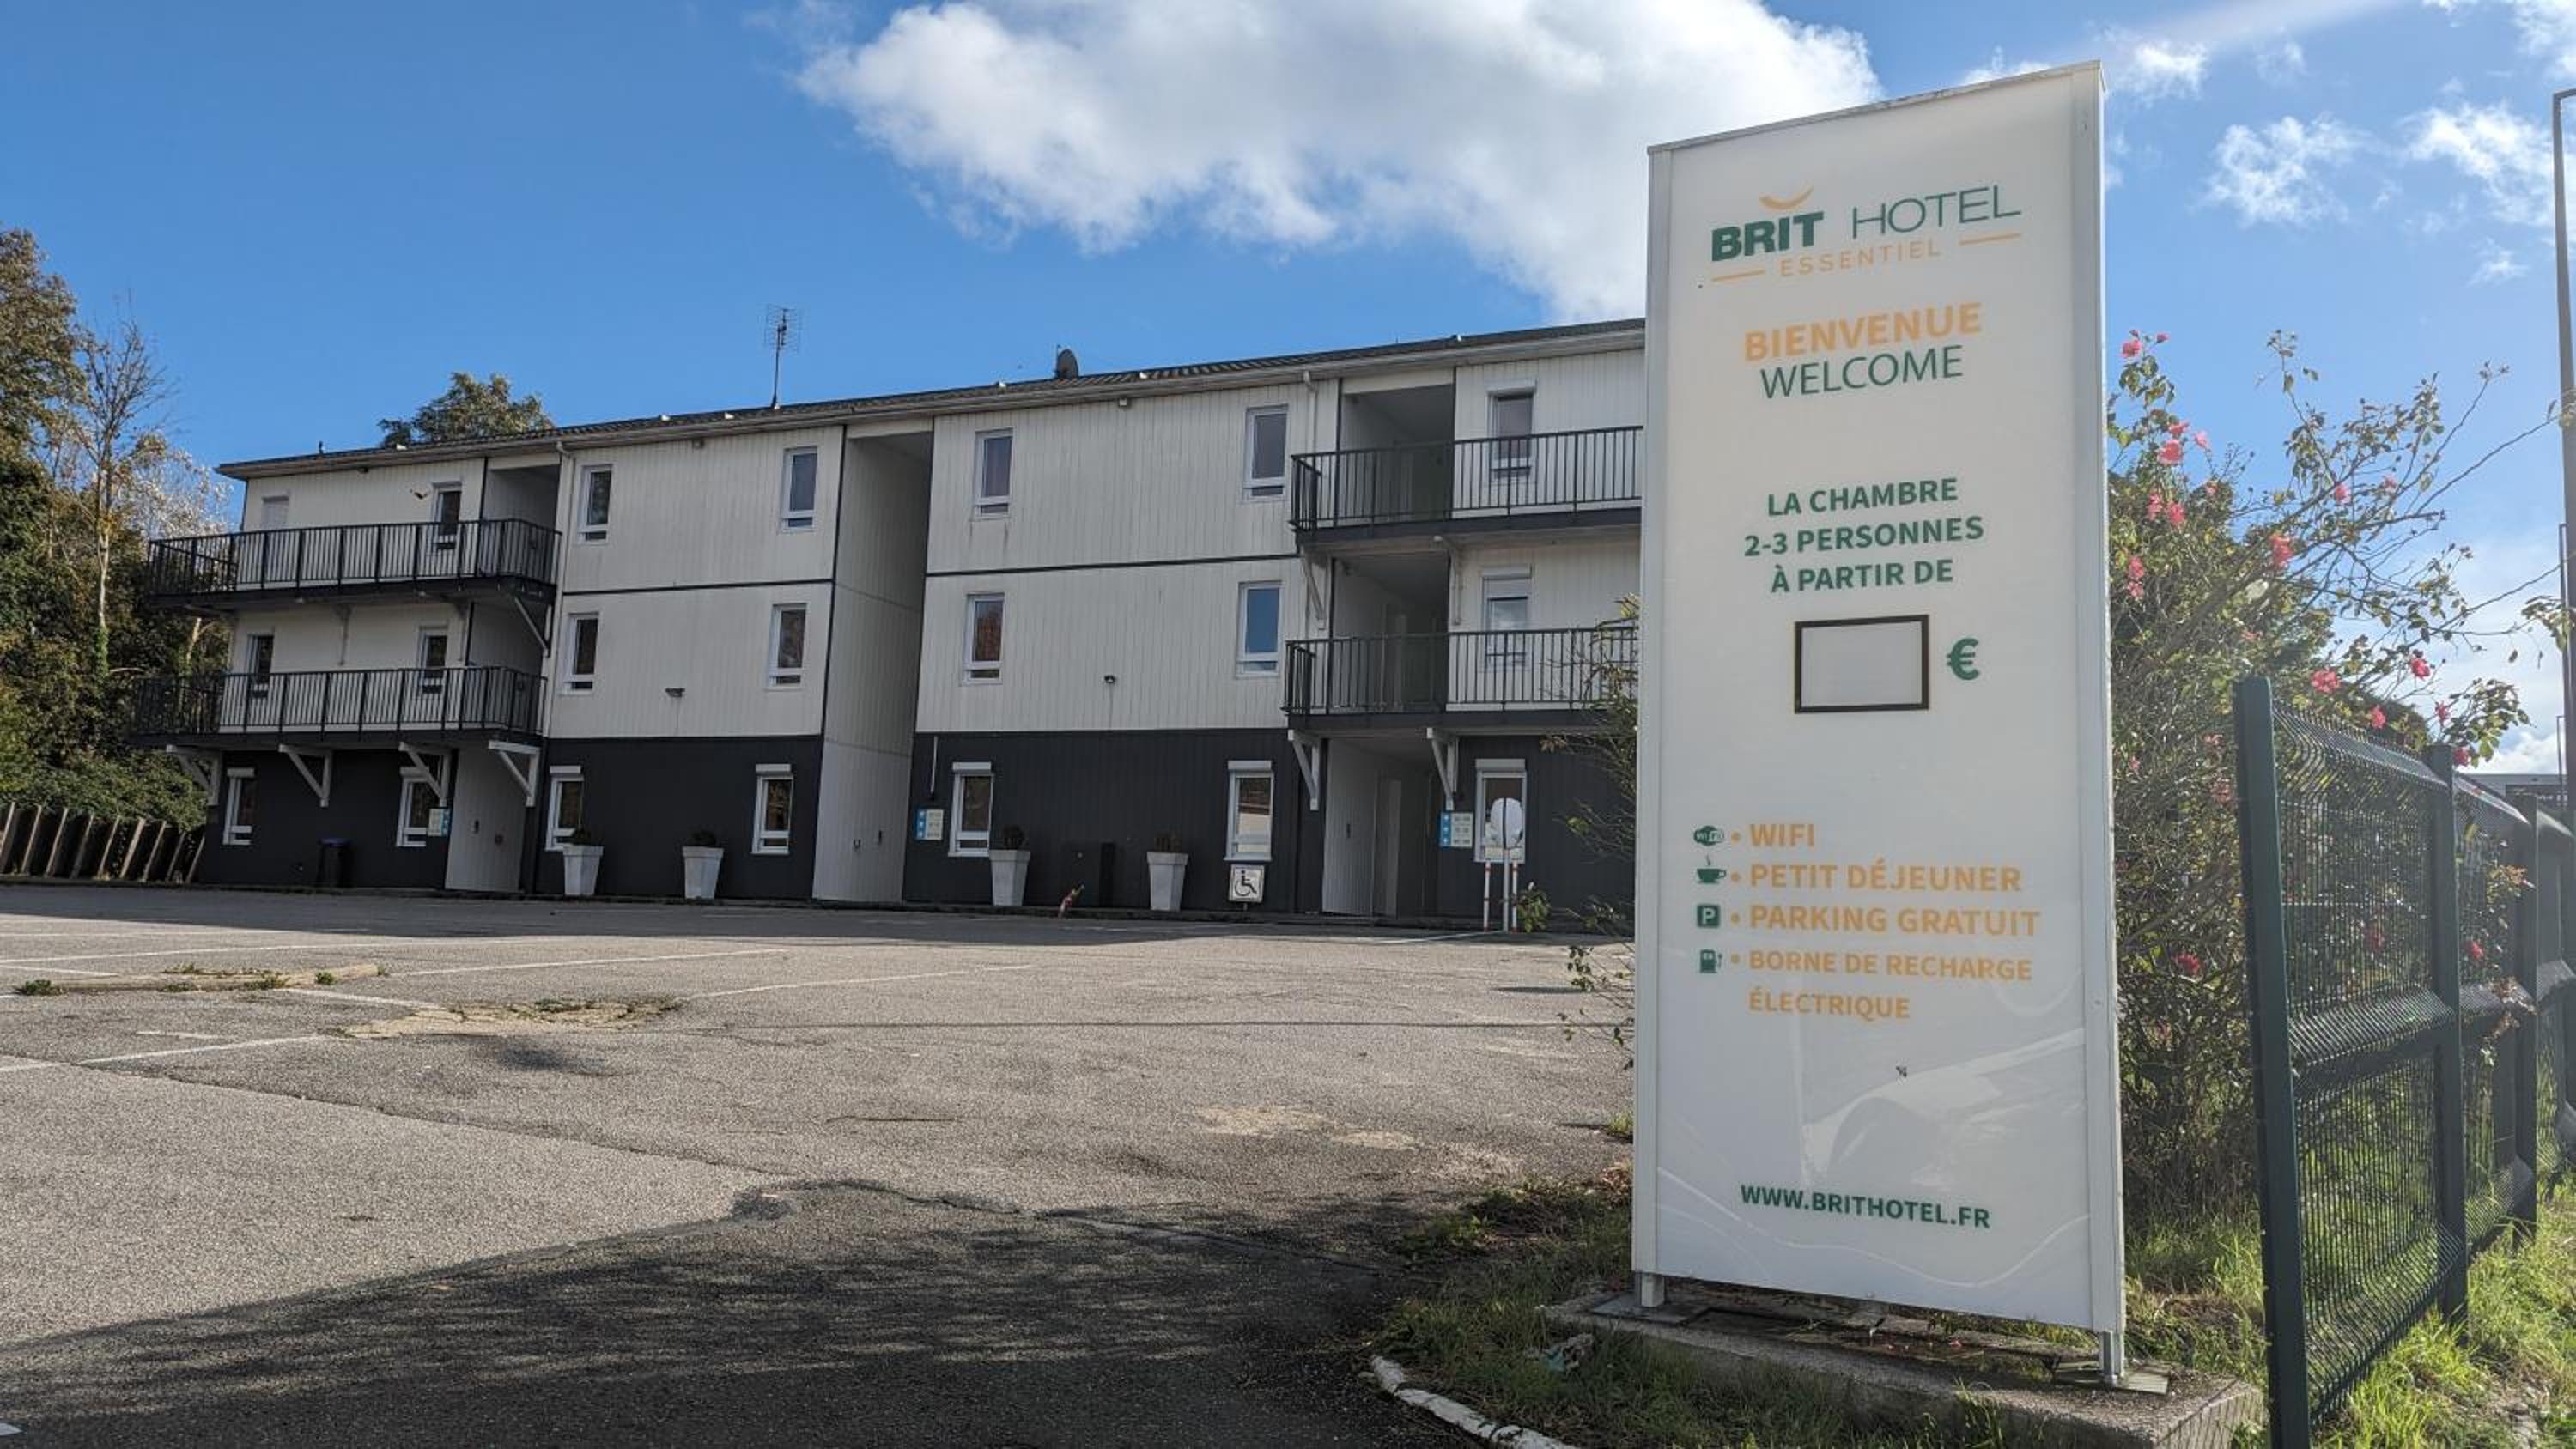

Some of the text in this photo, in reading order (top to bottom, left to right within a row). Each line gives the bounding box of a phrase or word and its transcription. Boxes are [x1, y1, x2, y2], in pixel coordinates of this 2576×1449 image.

[1711, 185, 2021, 262] BRIT HOTEL
[1780, 239, 1941, 277] ESSENTIEL
[1745, 302, 1982, 361] BIENVENUE
[1760, 345, 1963, 399] WELCOME
[1768, 478, 1958, 516] LA CHAMBRE
[1744, 515, 1984, 557] 2-3 PERSONNES
[1771, 559, 1953, 592] À PARTIR DE
[1947, 638, 1979, 680] €
[1749, 823, 1815, 847] WIFI
[1751, 859, 2022, 892] PETIT DÉJEUNER
[1702, 907, 1715, 925] P
[1751, 906, 2040, 937] PARKING GRATUIT
[1750, 950, 2032, 981] BORNE DE RECHARGE
[1749, 986, 1911, 1021] ÉLECTRIQUE
[1741, 1185, 1990, 1228] WWW.BRITHOTEL.FR
